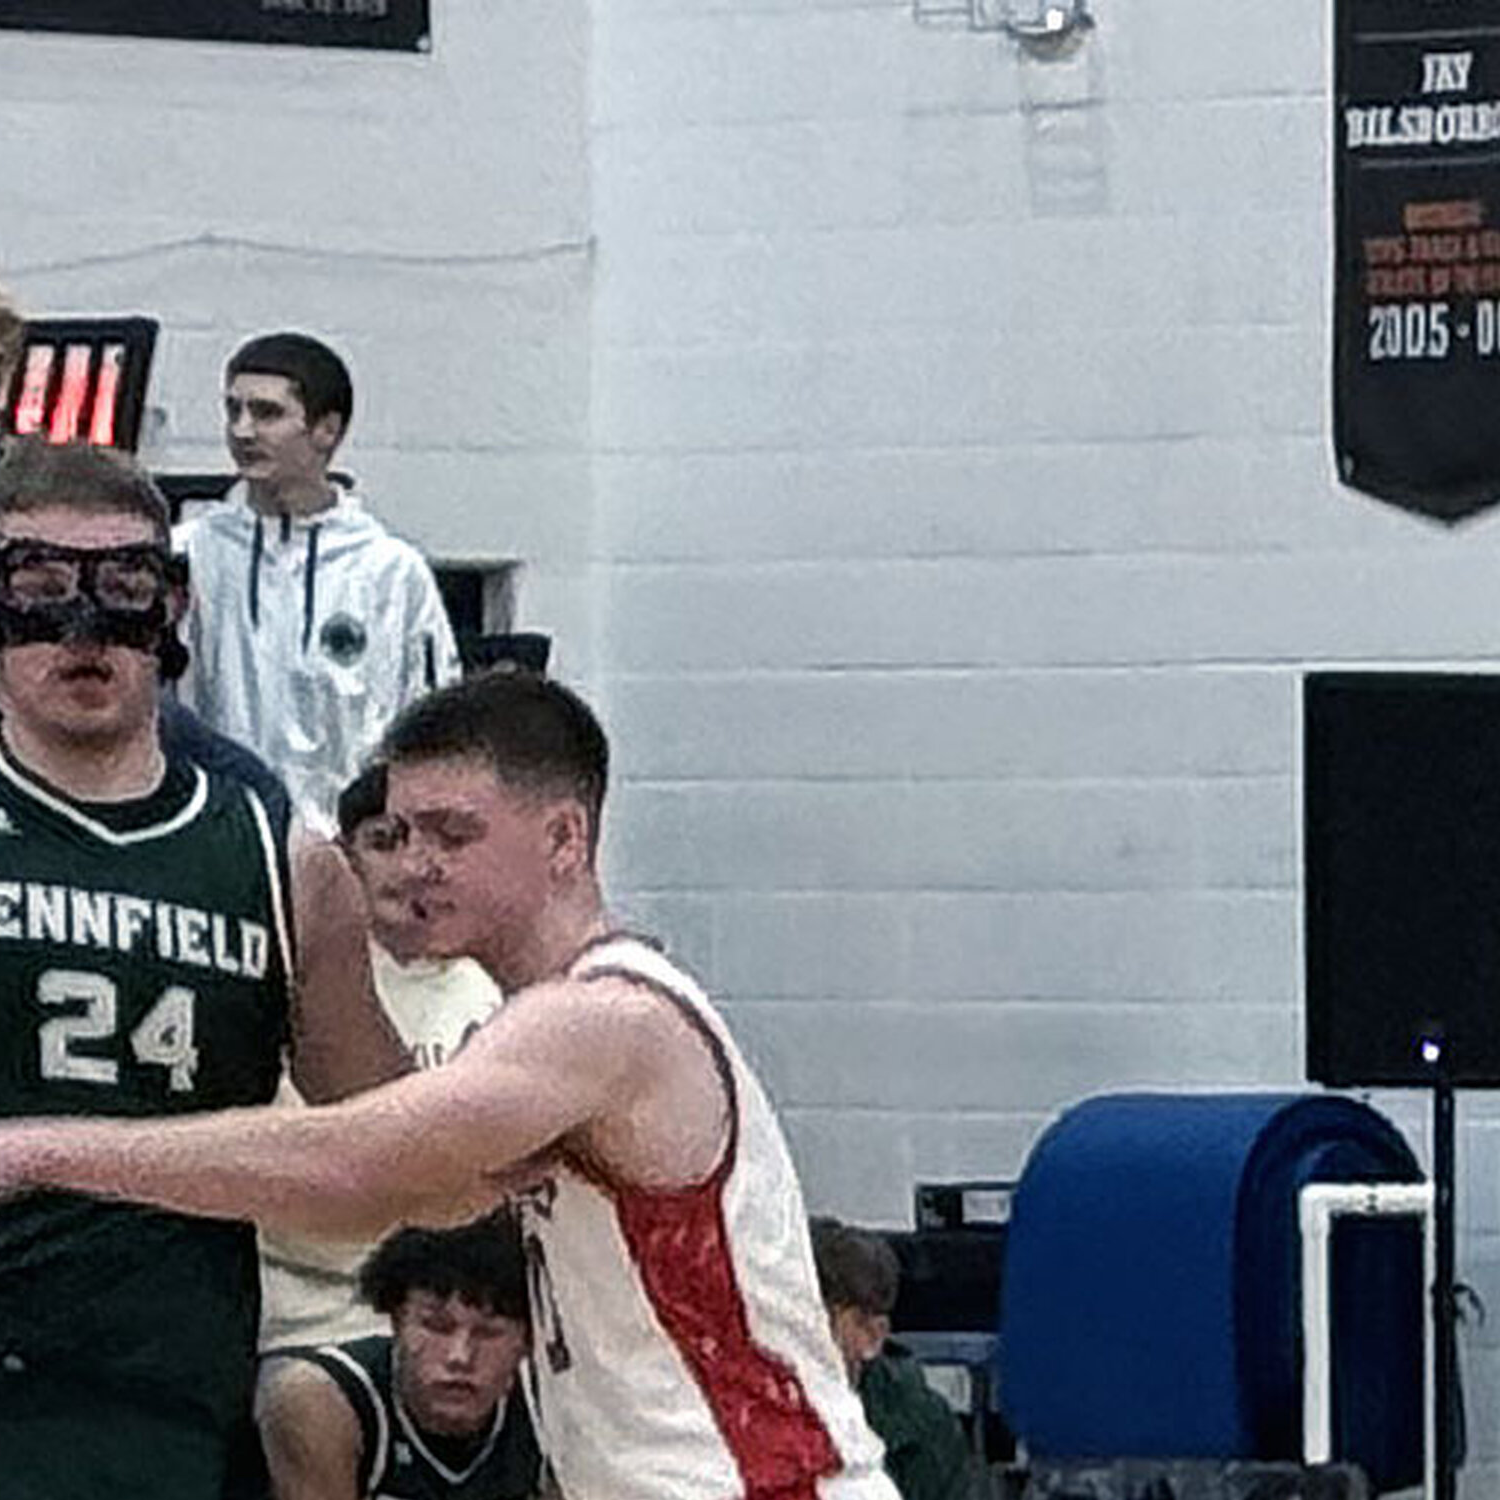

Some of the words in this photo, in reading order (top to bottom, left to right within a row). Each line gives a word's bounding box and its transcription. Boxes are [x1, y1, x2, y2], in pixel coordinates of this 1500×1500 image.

[1421, 52, 1472, 93] JAY
[1368, 302, 1450, 361] 2005
[36, 967, 200, 1093] 24
